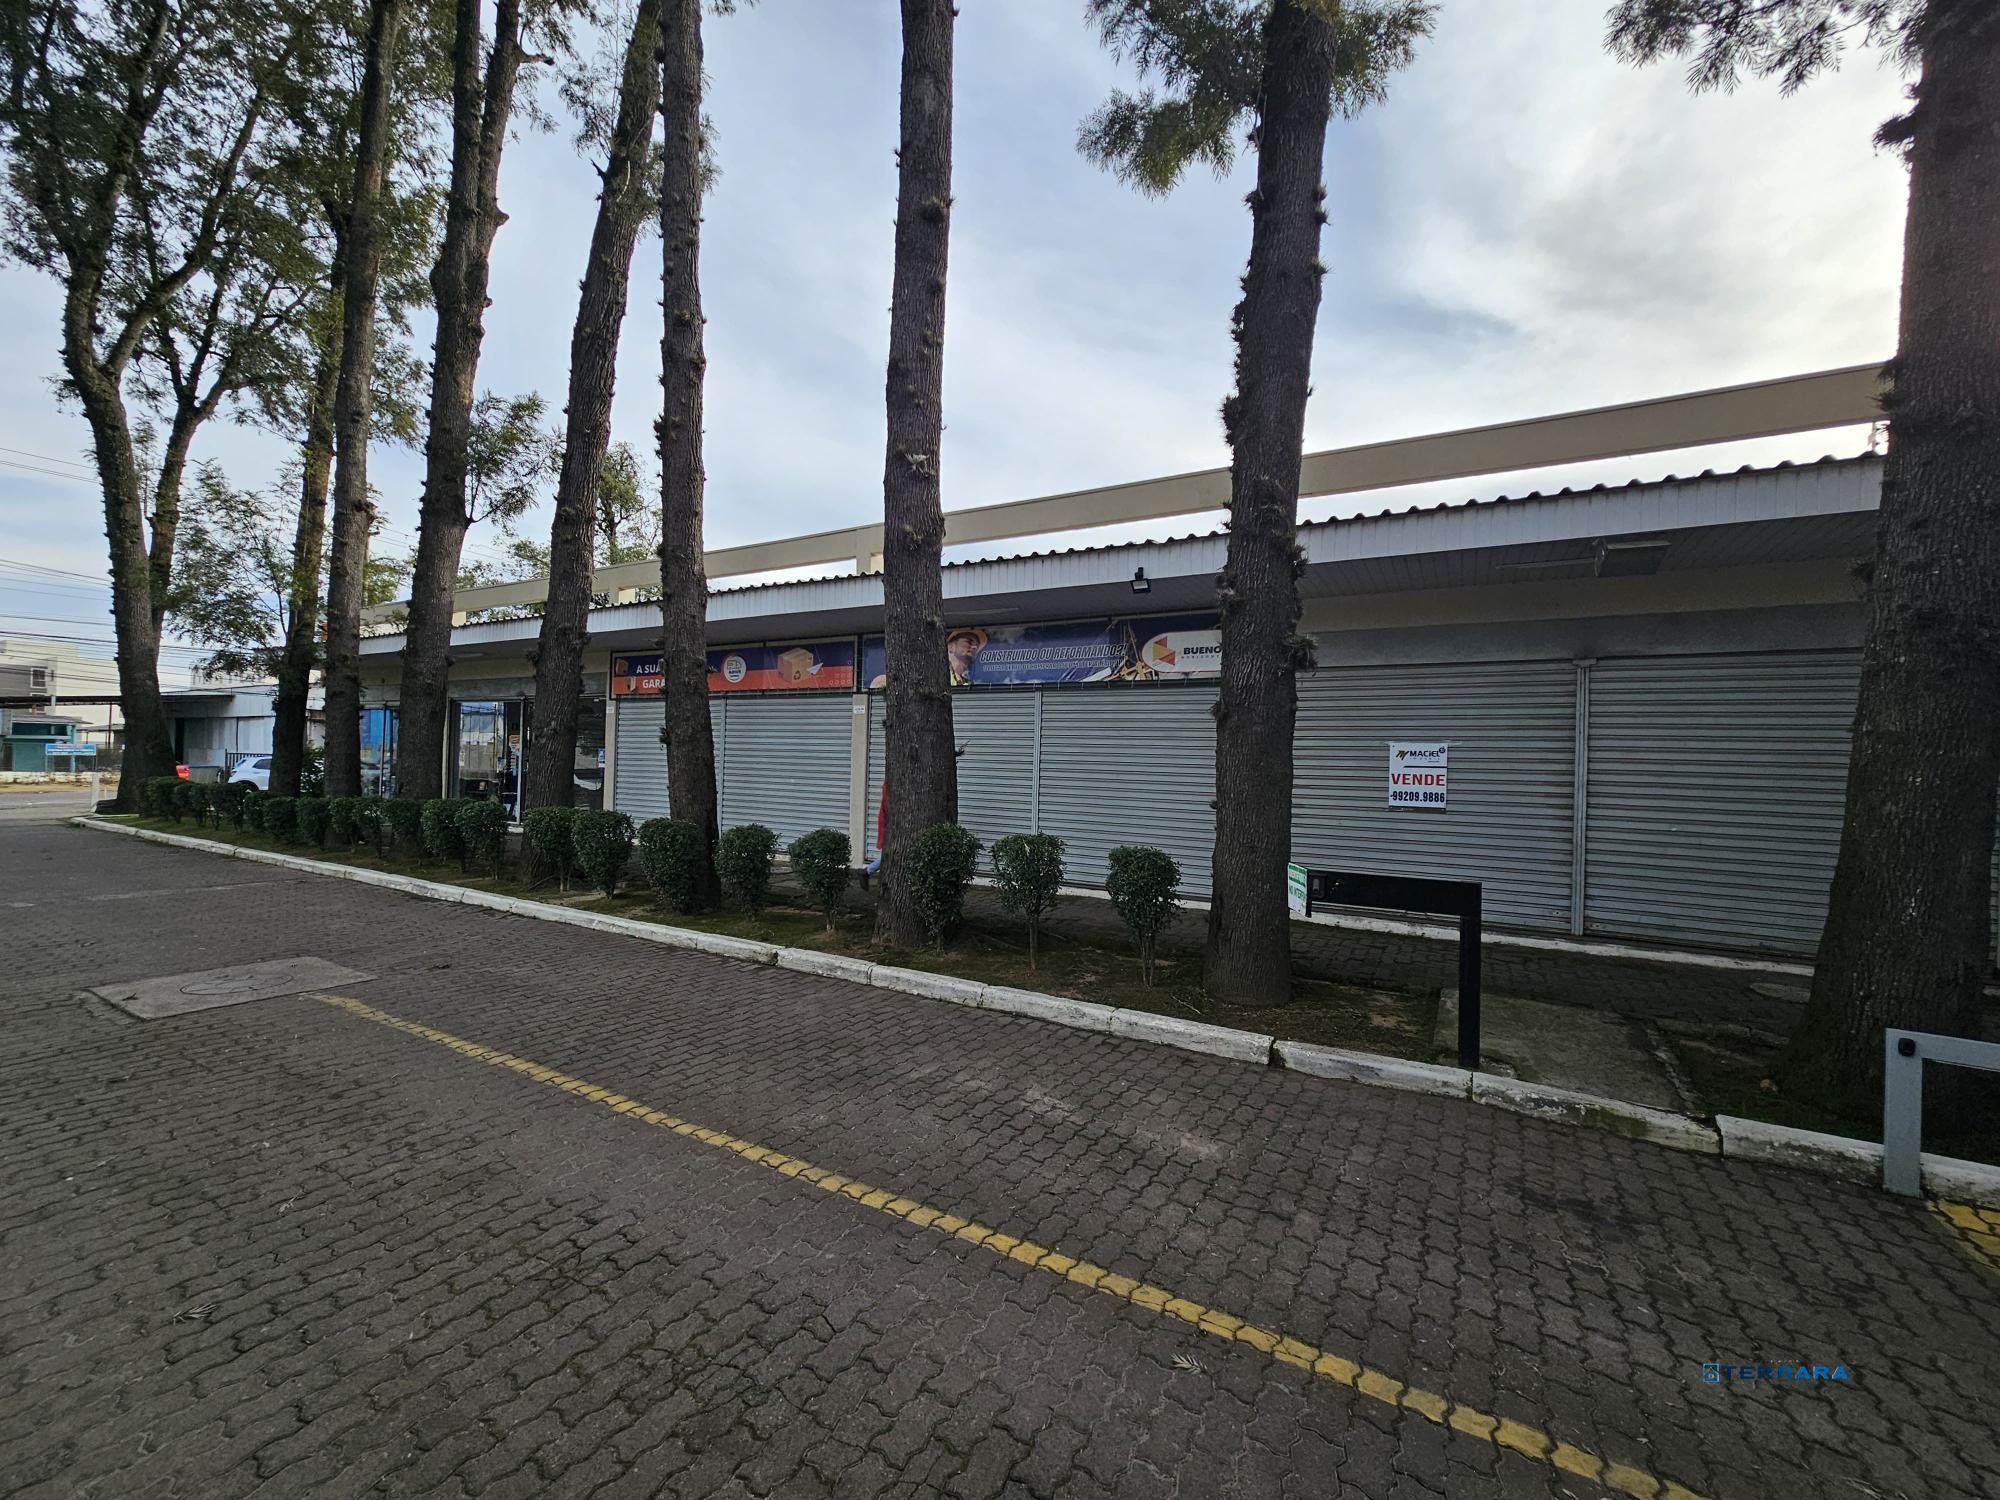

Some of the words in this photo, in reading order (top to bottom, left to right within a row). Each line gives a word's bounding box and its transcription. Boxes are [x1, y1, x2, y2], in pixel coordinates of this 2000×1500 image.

[980, 648, 1040, 663] CONSTRUINDO
[1039, 647, 1054, 661] OU
[1183, 645, 1222, 655] BUENO
[636, 664, 643, 674] A
[1391, 773, 1446, 786] VENDE
